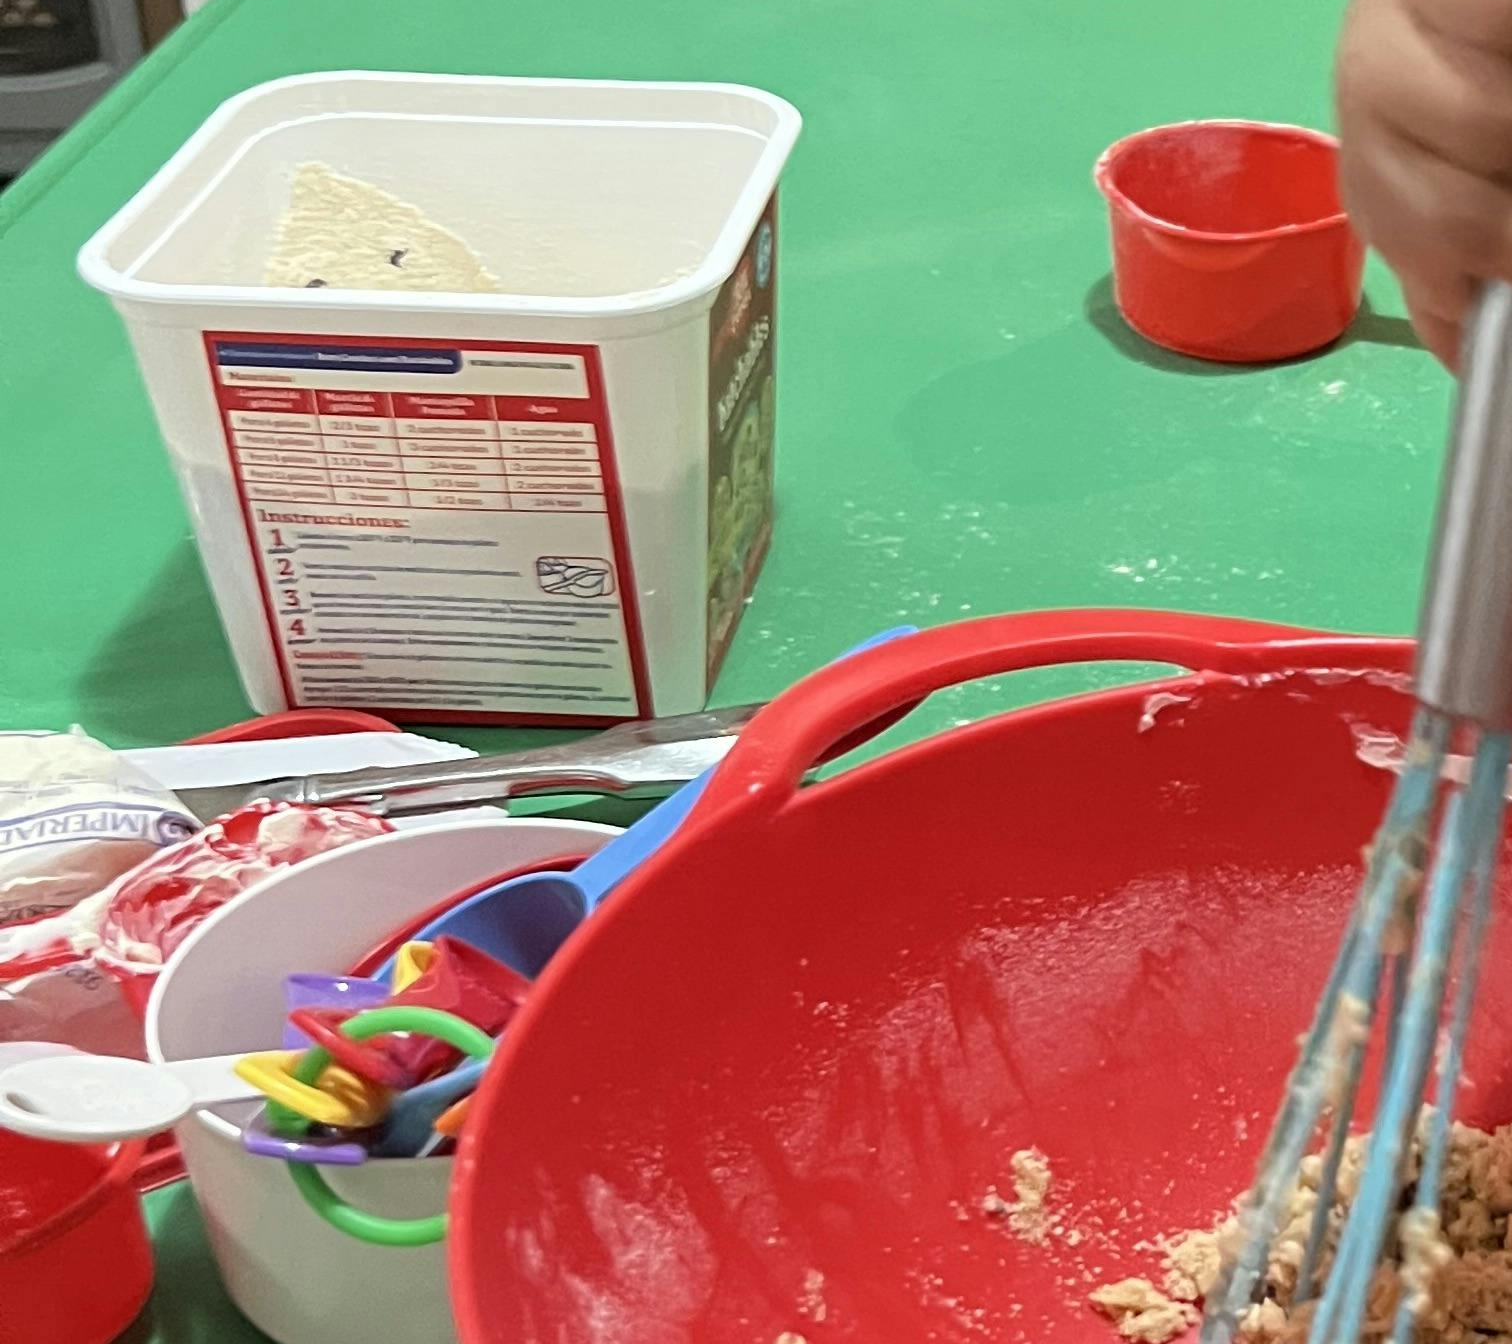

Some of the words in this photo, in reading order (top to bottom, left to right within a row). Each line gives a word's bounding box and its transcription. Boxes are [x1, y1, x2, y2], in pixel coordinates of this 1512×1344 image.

[270, 529, 284, 547] 1
[277, 558, 295, 576] 2
[282, 589, 300, 606] 3
[289, 618, 305, 636] 4
